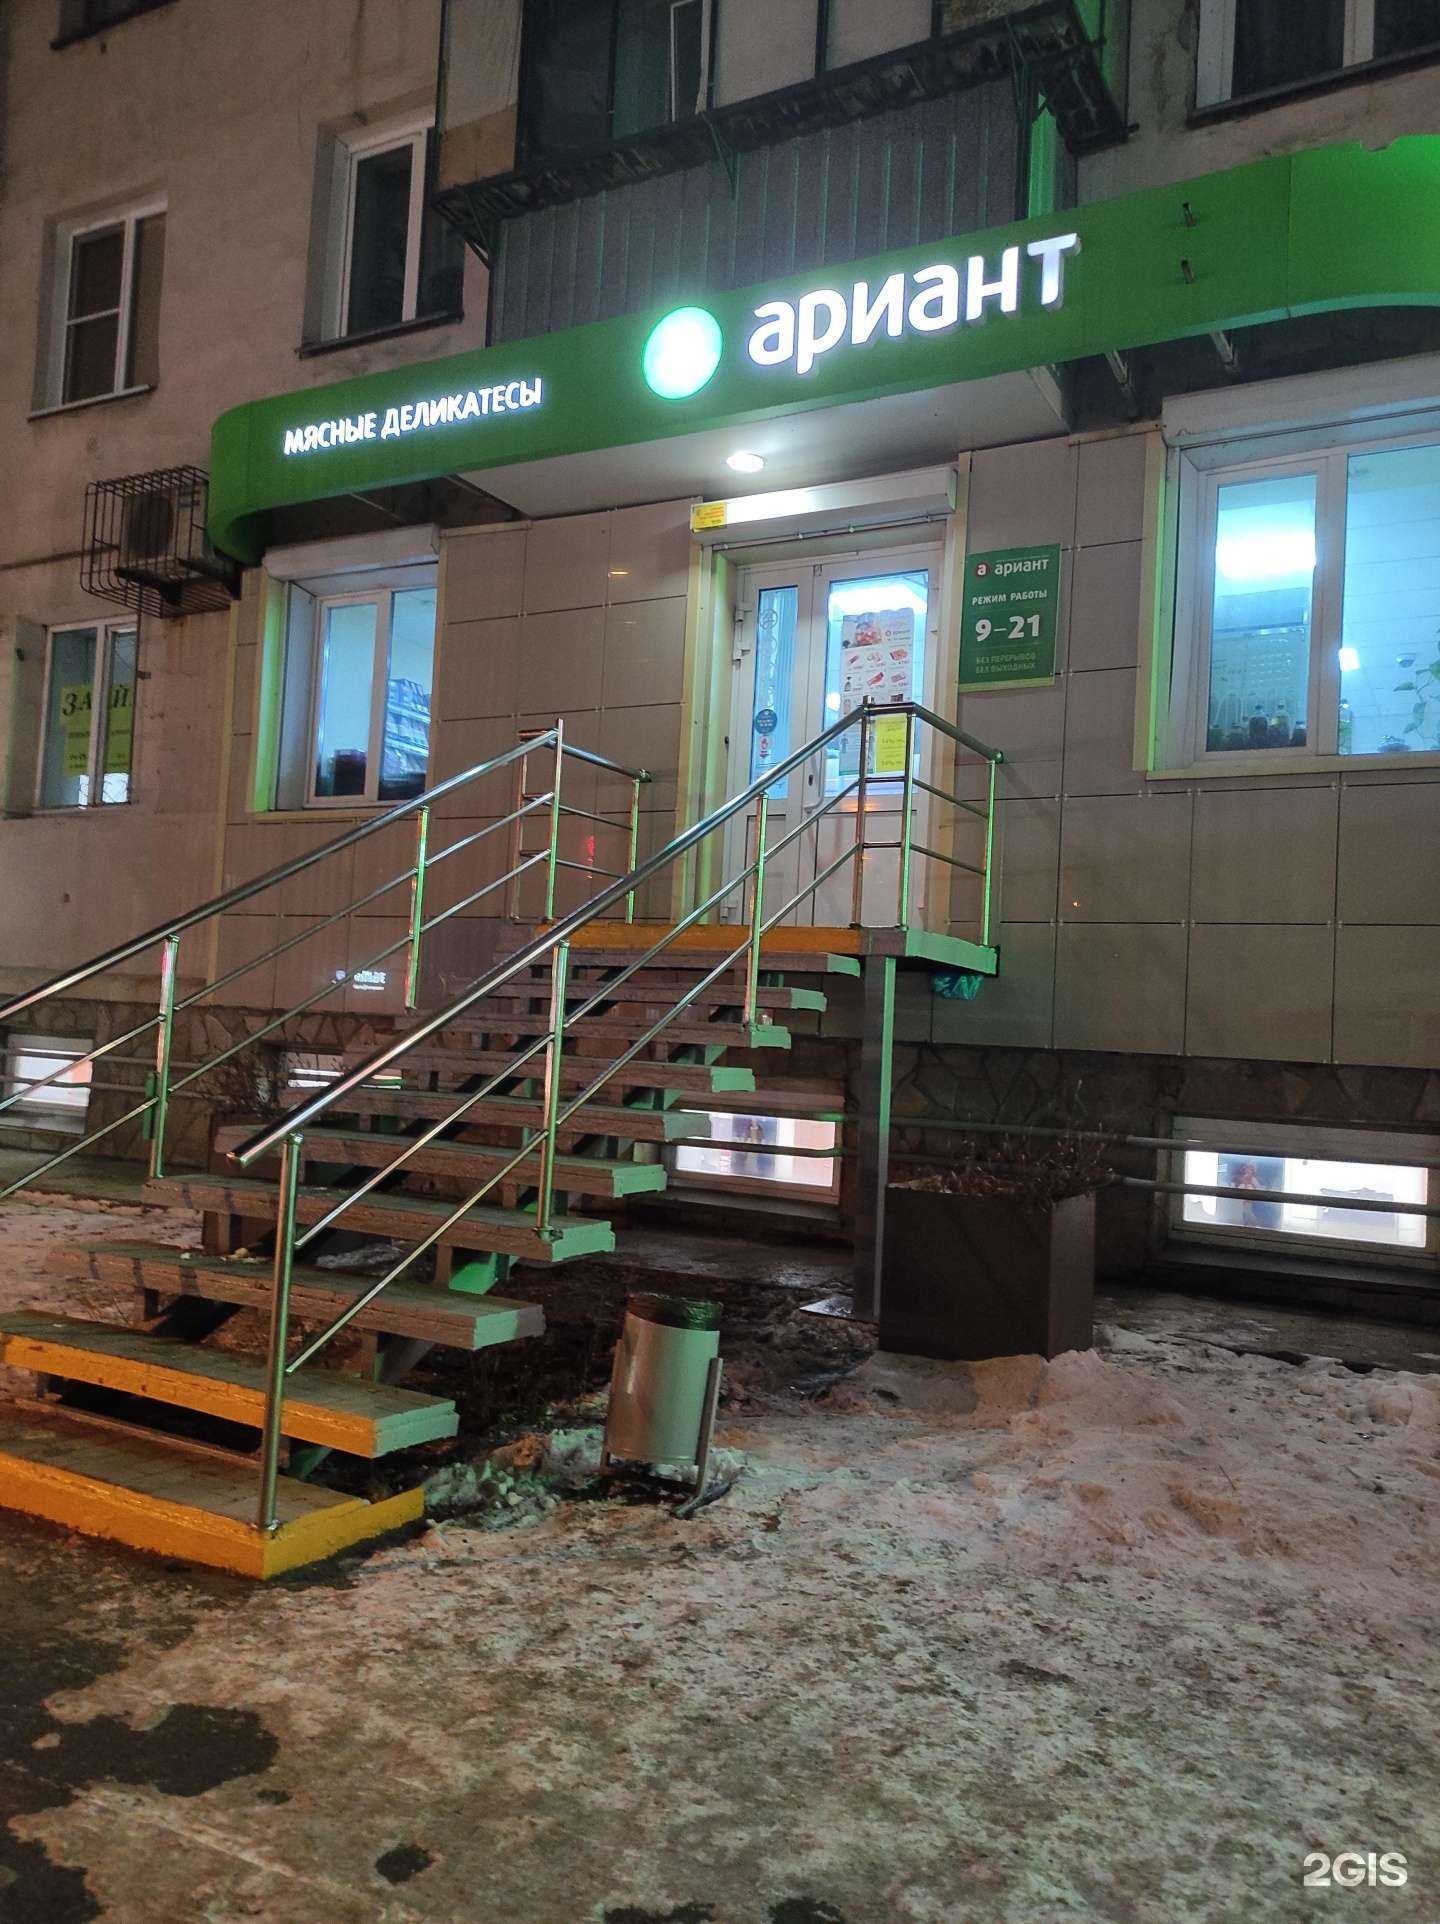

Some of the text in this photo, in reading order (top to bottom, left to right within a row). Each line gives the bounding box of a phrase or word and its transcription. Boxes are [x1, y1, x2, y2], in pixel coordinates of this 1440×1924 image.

[748, 233, 1079, 375] ариант
[283, 378, 542, 455] МЯСНЫЕ ДЕЛИКАТЕСЫ
[994, 559, 1049, 577] ариант
[972, 589, 1048, 606] РЕЖИМ РАБОТЫ
